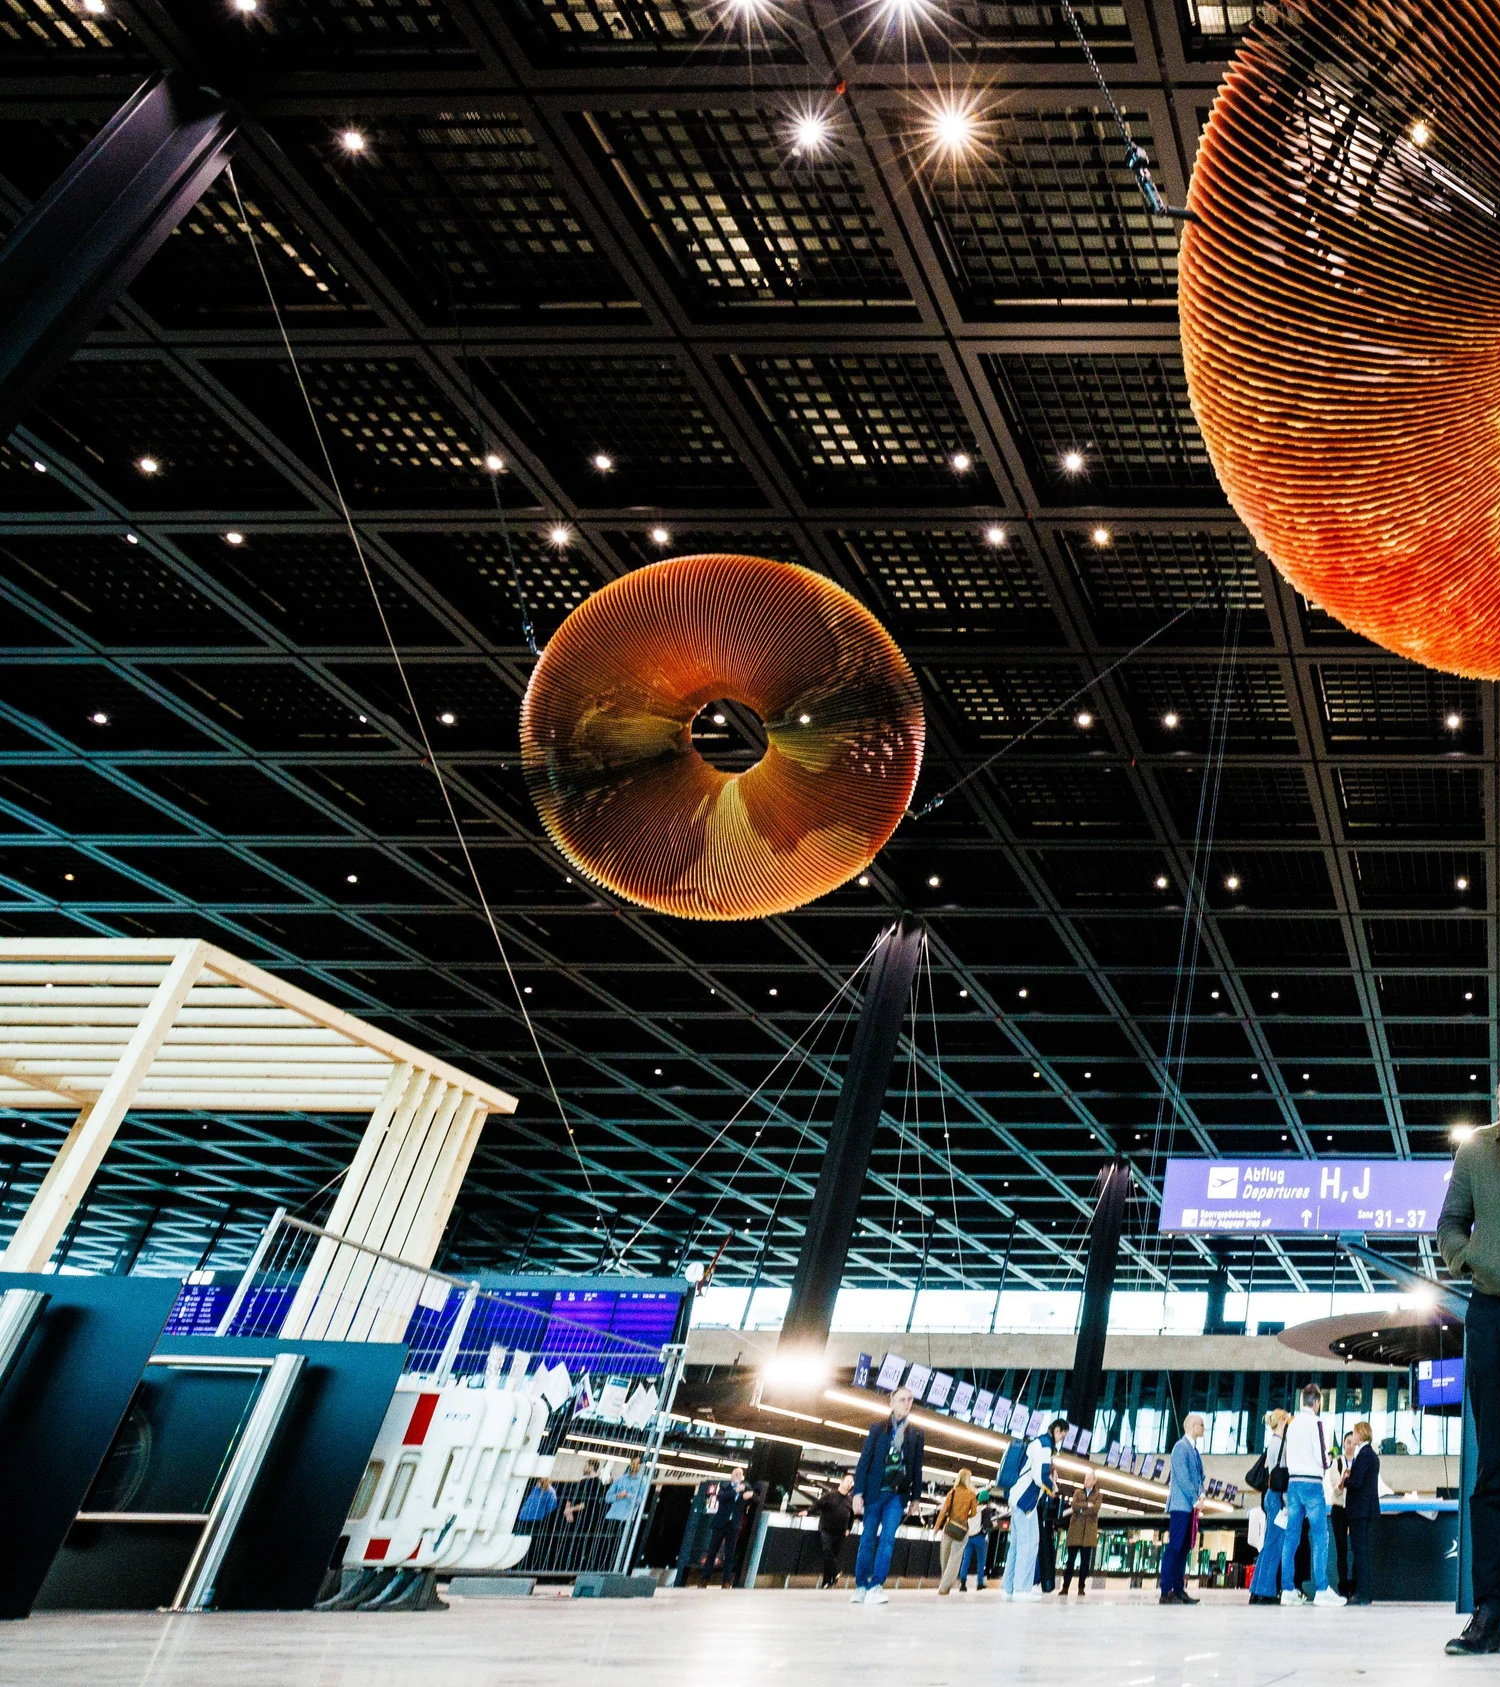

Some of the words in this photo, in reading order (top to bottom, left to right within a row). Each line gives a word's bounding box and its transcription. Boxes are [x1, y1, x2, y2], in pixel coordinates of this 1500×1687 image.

[1243, 1166, 1285, 1184] Abflug
[1242, 1184, 1310, 1202] Departures
[858, 1367, 868, 1386] 33
